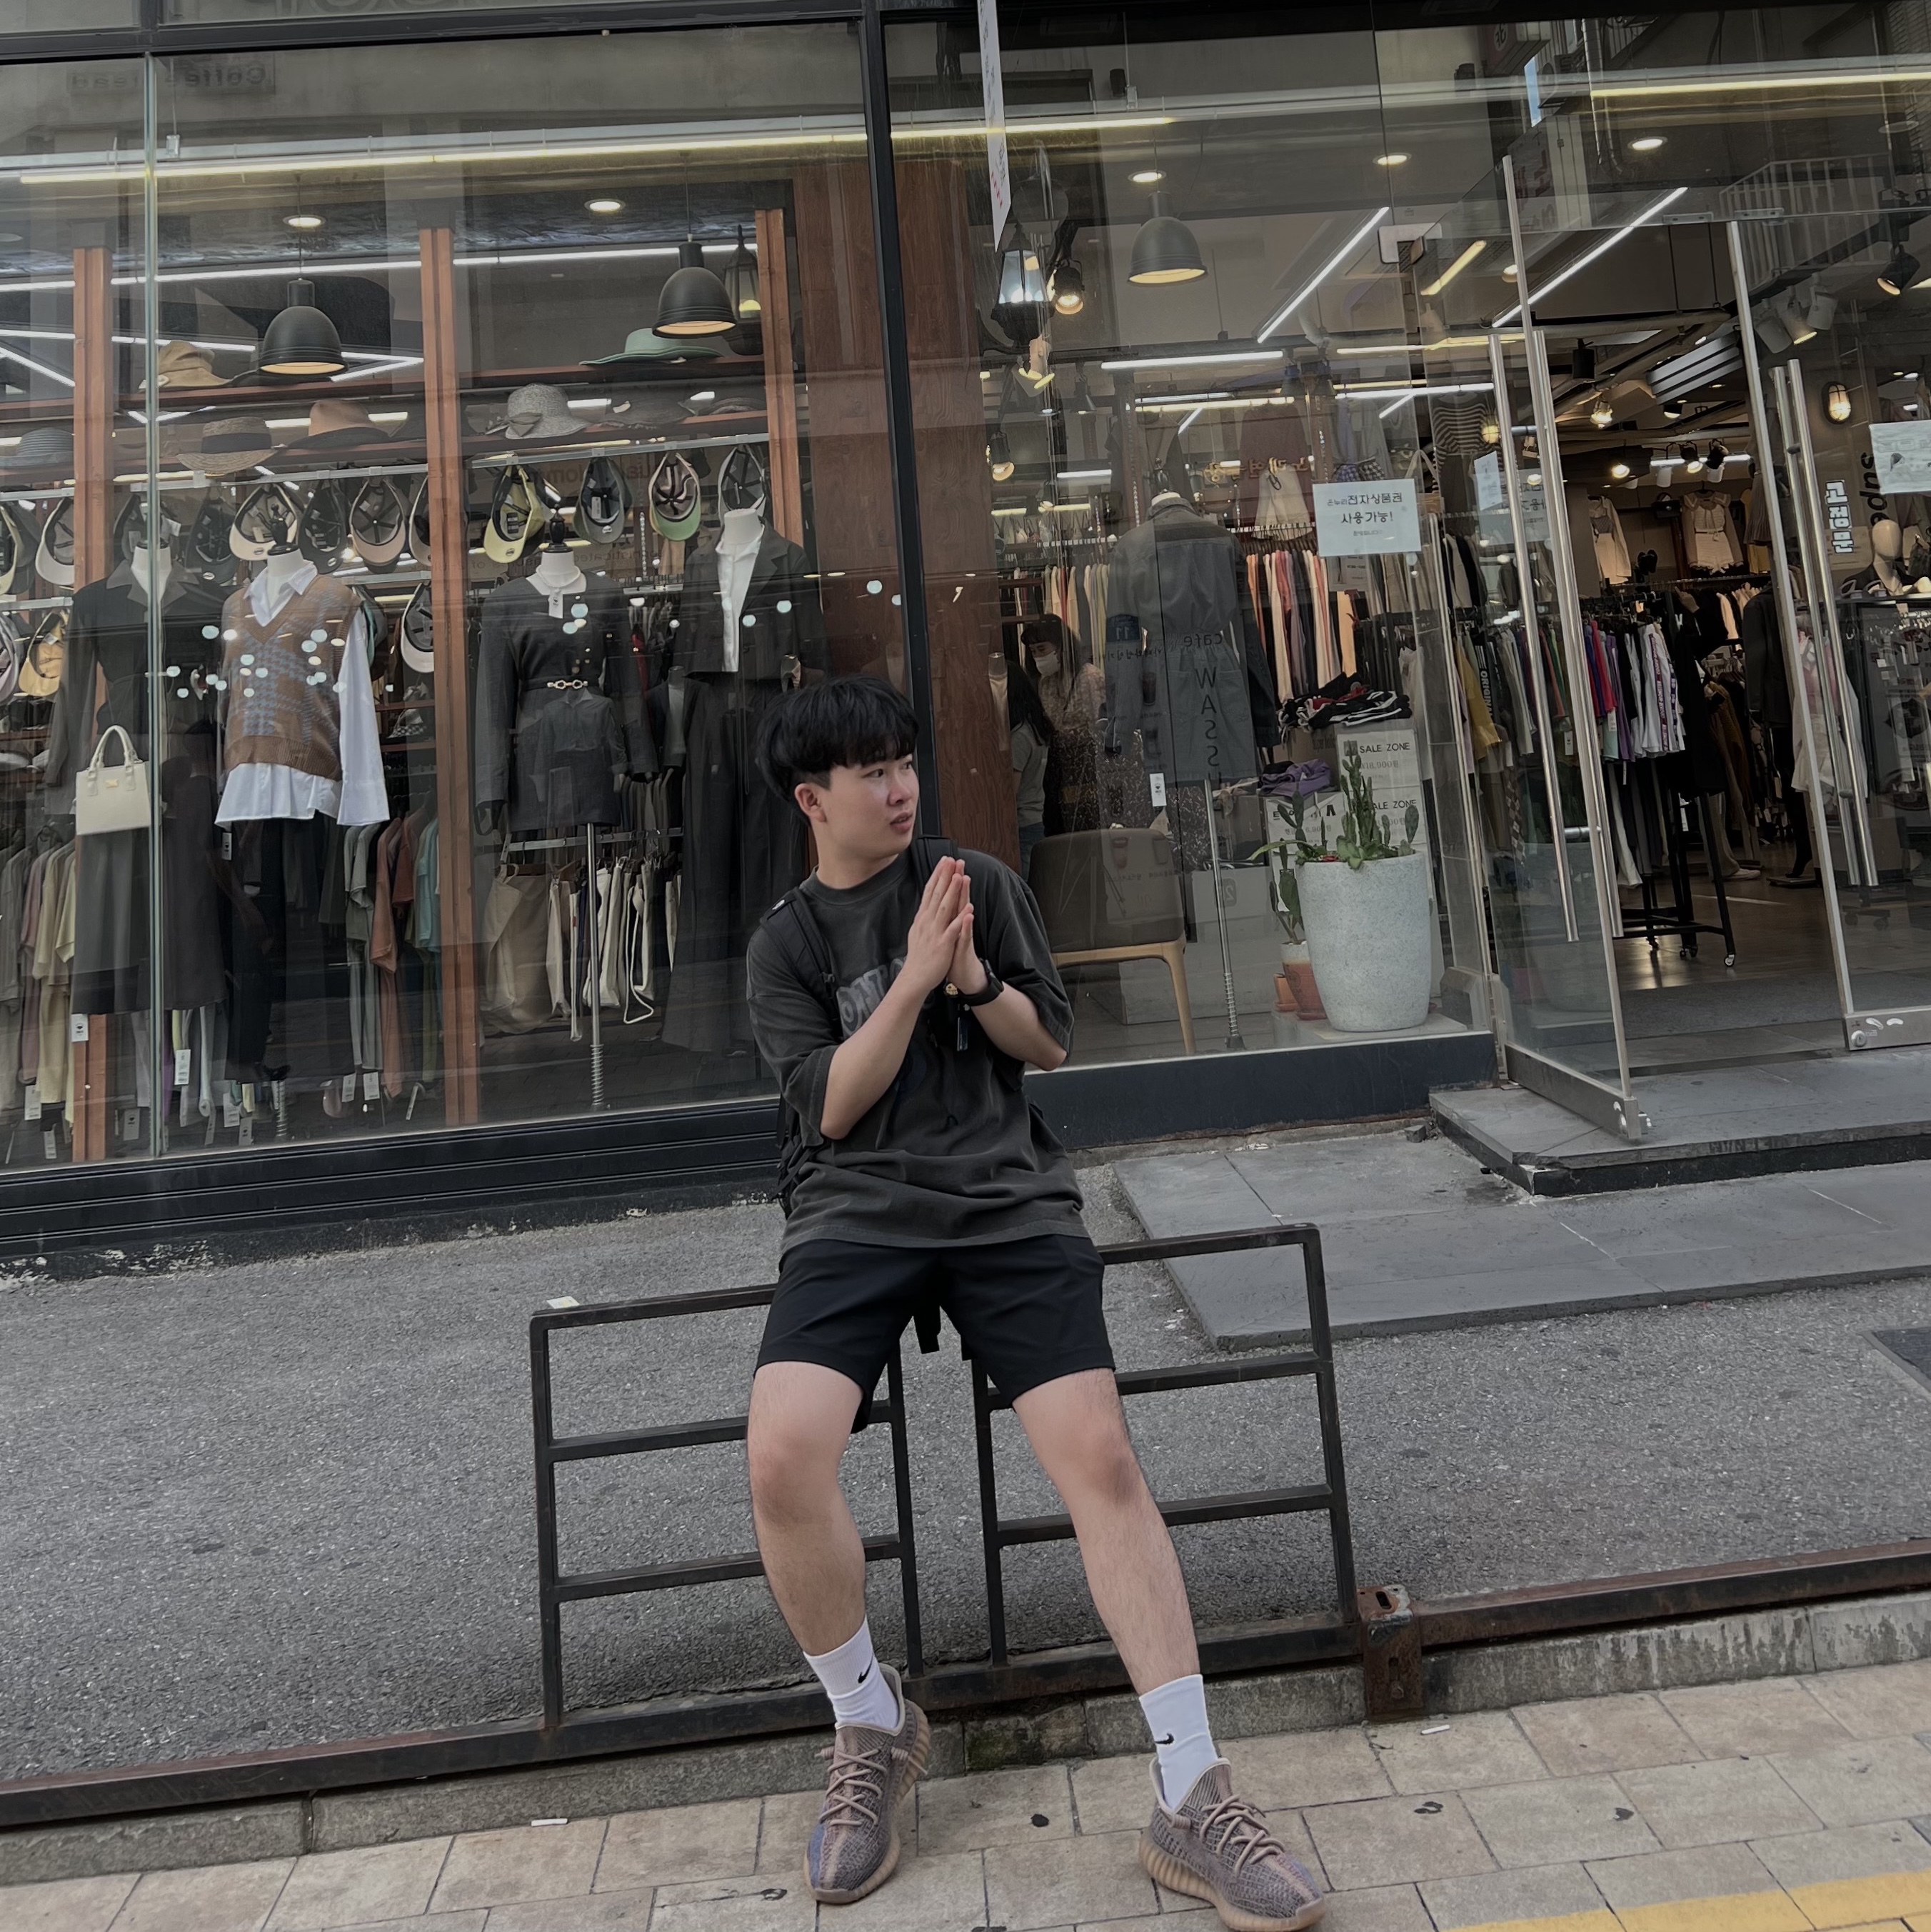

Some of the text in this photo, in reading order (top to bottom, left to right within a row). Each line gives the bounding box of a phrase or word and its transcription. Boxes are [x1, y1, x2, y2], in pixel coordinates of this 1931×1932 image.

[1825, 480, 1853, 554] 고정문
[1360, 742, 1410, 754] SALE ZONE
[1373, 801, 1388, 810] ALE
